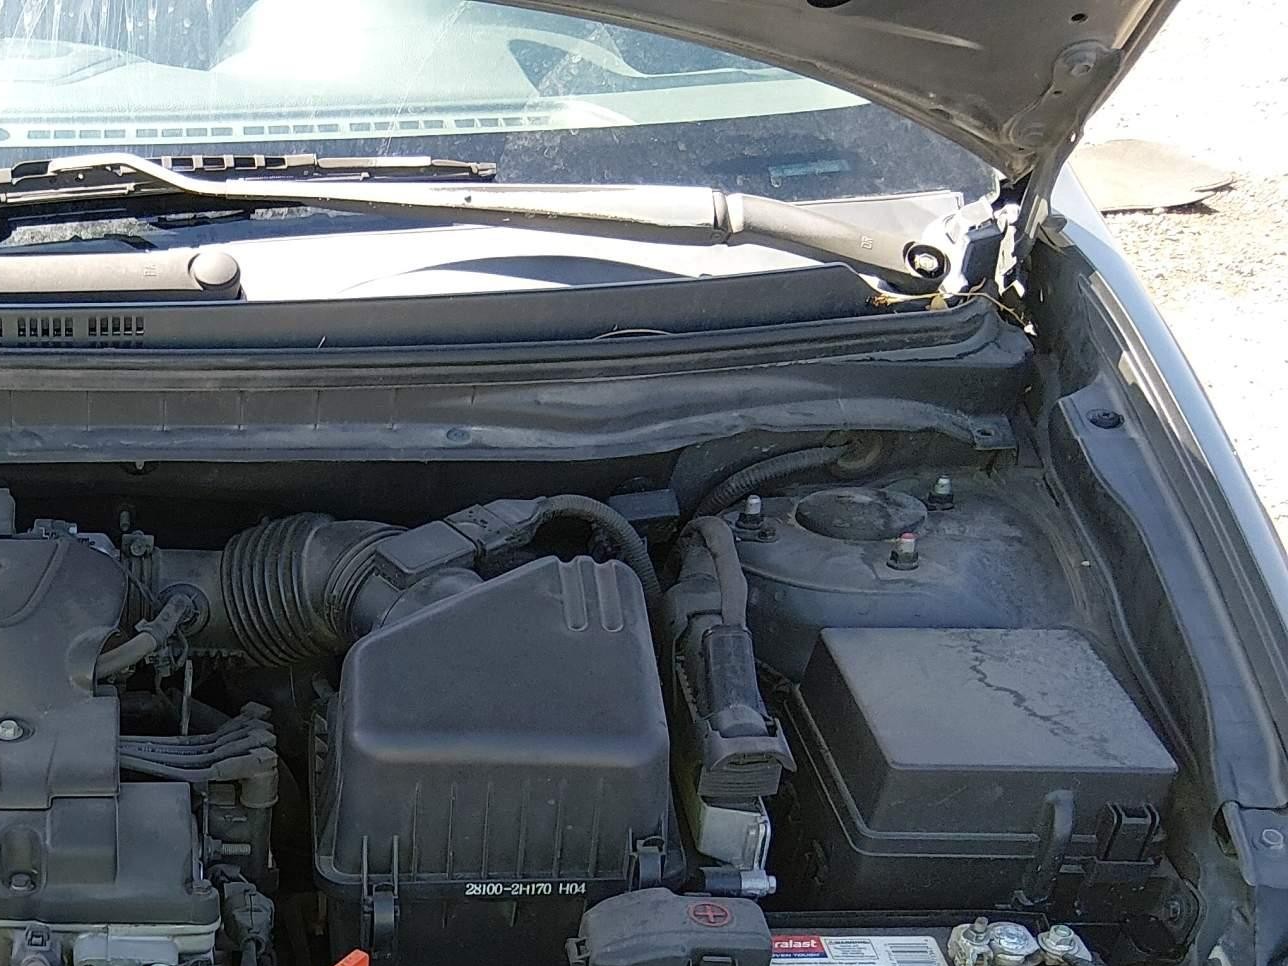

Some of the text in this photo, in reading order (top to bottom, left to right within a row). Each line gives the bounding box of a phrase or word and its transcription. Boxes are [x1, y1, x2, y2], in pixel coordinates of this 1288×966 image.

[464, 882, 587, 896] 28100-2H170 H04
[774, 938, 818, 949] ralast
